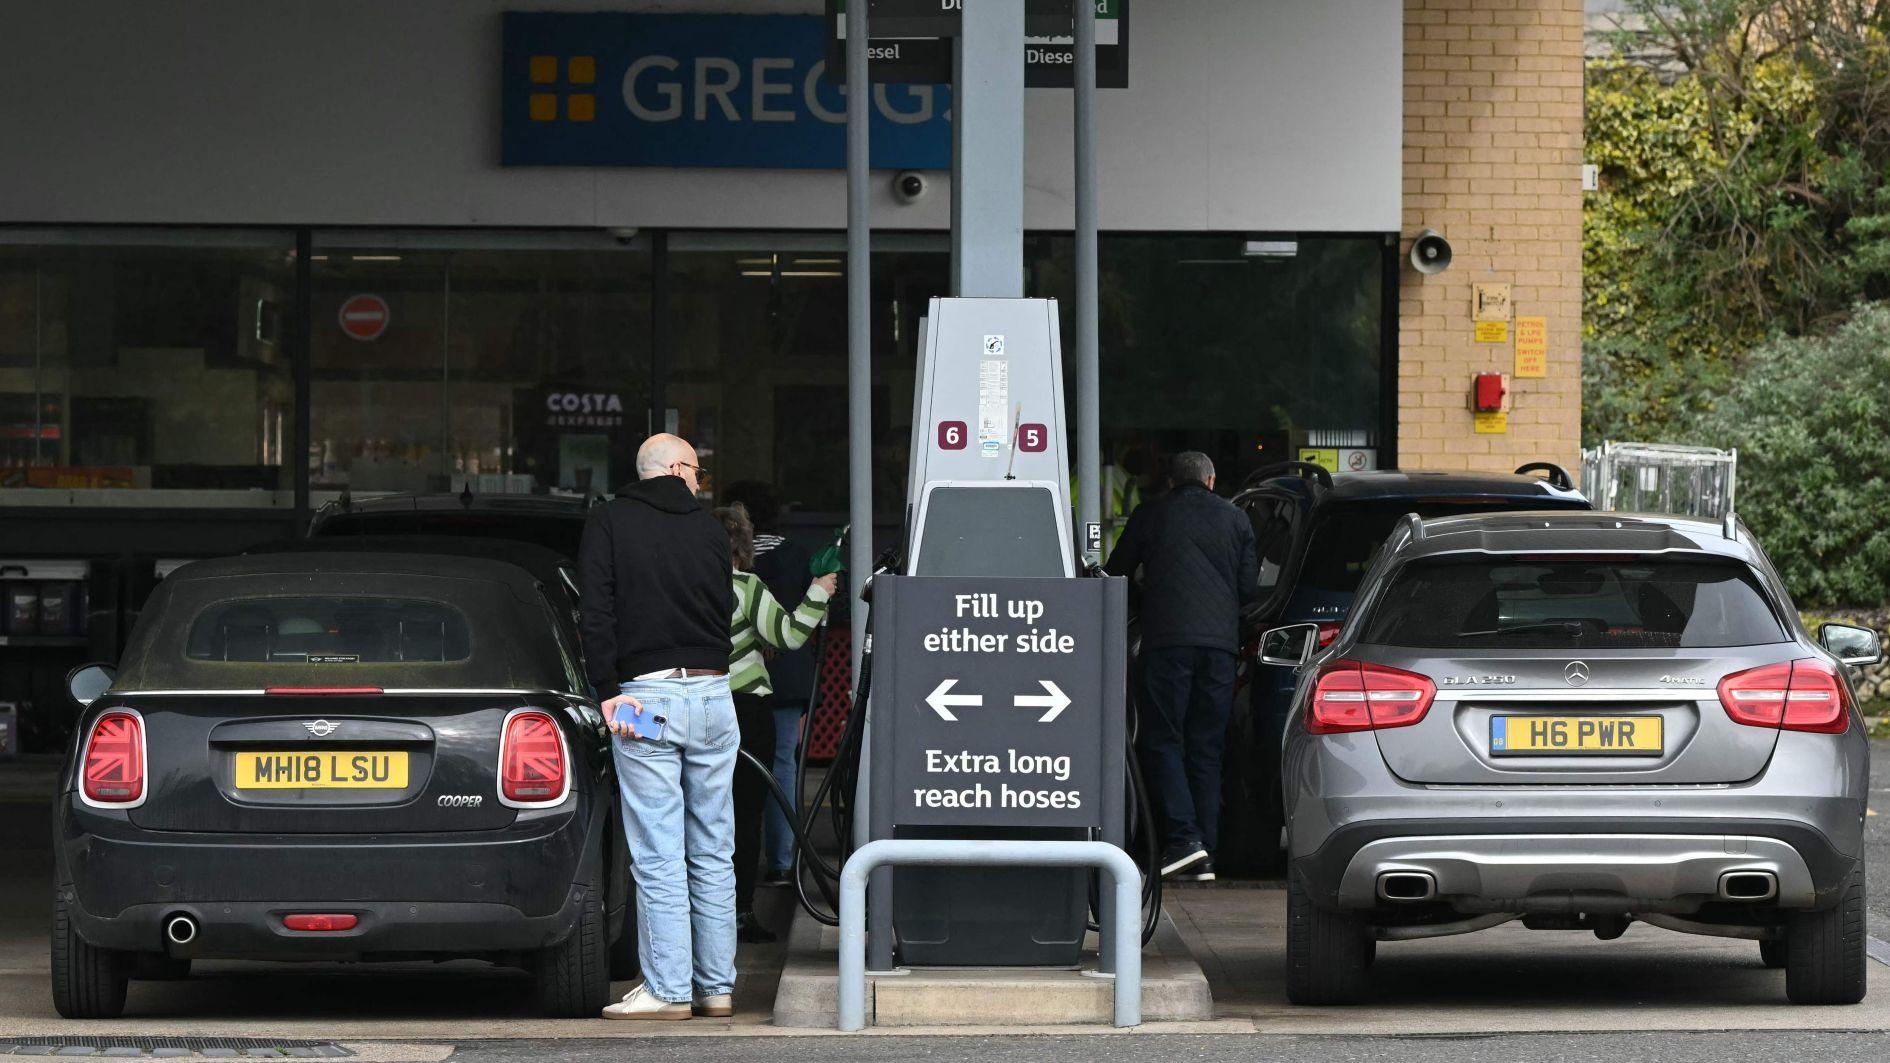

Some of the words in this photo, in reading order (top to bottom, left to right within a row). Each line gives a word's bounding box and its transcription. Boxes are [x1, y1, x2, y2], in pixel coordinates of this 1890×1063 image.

[867, 44, 900, 59] esel
[1026, 49, 1073, 64] Diese
[622, 55, 951, 123] GREGG
[546, 393, 622, 413] COSTA
[946, 427, 960, 444] 6
[1027, 429, 1039, 447] 5
[955, 593, 999, 618] Fill
[1007, 600, 1044, 624] up
[923, 627, 1008, 653] either
[1016, 628, 1075, 654] side
[1443, 675, 1478, 685] GLA
[1481, 675, 1516, 685] 250
[1659, 674, 1705, 685] 4MATIC
[1530, 720, 1568, 747] H6
[1578, 720, 1635, 747] PWR
[255, 755, 321, 782] MH18
[331, 755, 389, 782] LSU
[926, 749, 1000, 773] Extra
[1008, 749, 1071, 781] long
[437, 795, 482, 807] COOPER
[914, 783, 992, 808] reach
[1001, 784, 1081, 808] hoses
